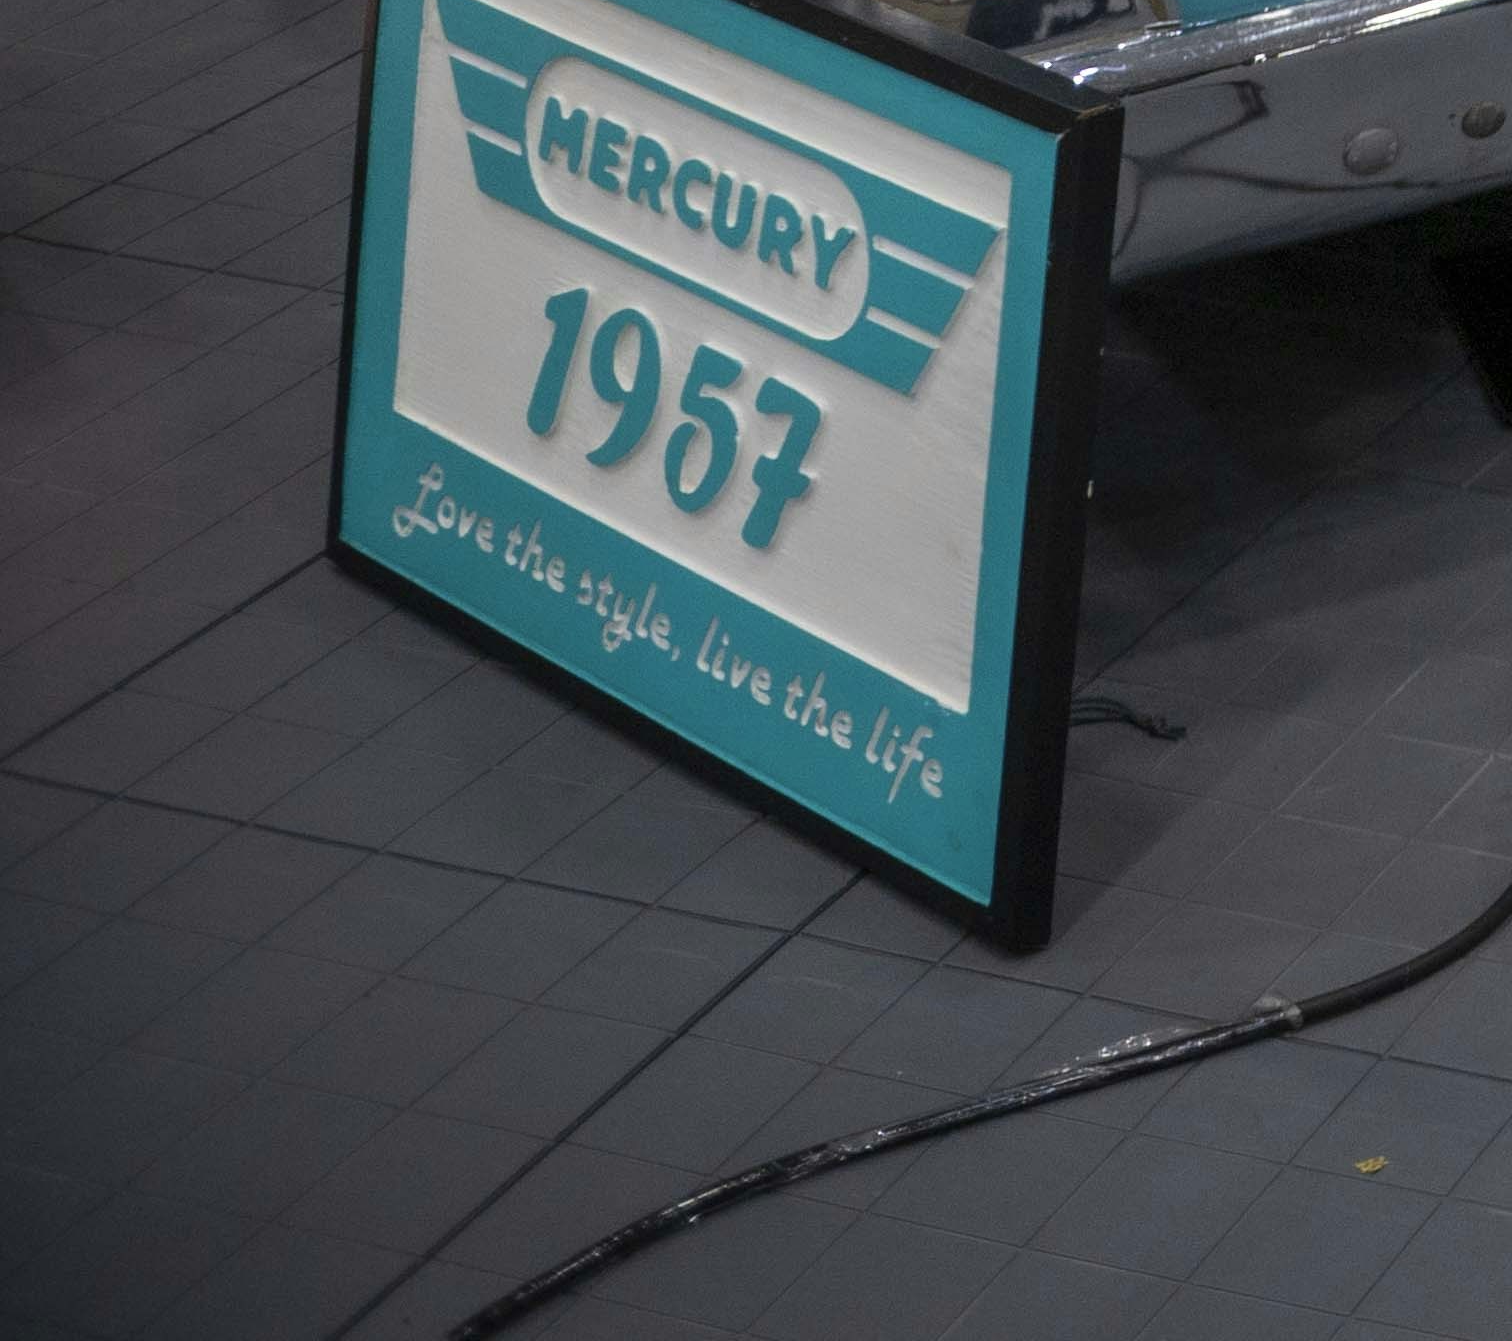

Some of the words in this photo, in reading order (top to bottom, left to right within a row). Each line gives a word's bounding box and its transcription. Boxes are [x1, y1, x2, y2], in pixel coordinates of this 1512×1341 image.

[538, 95, 858, 291] MERCURY
[526, 287, 822, 551] 1957
[392, 462, 495, 554] Love
[504, 518, 566, 593] the
[575, 569, 681, 662] style,
[695, 617, 772, 706] live
[785, 671, 853, 750] the
[863, 705, 944, 804] life
